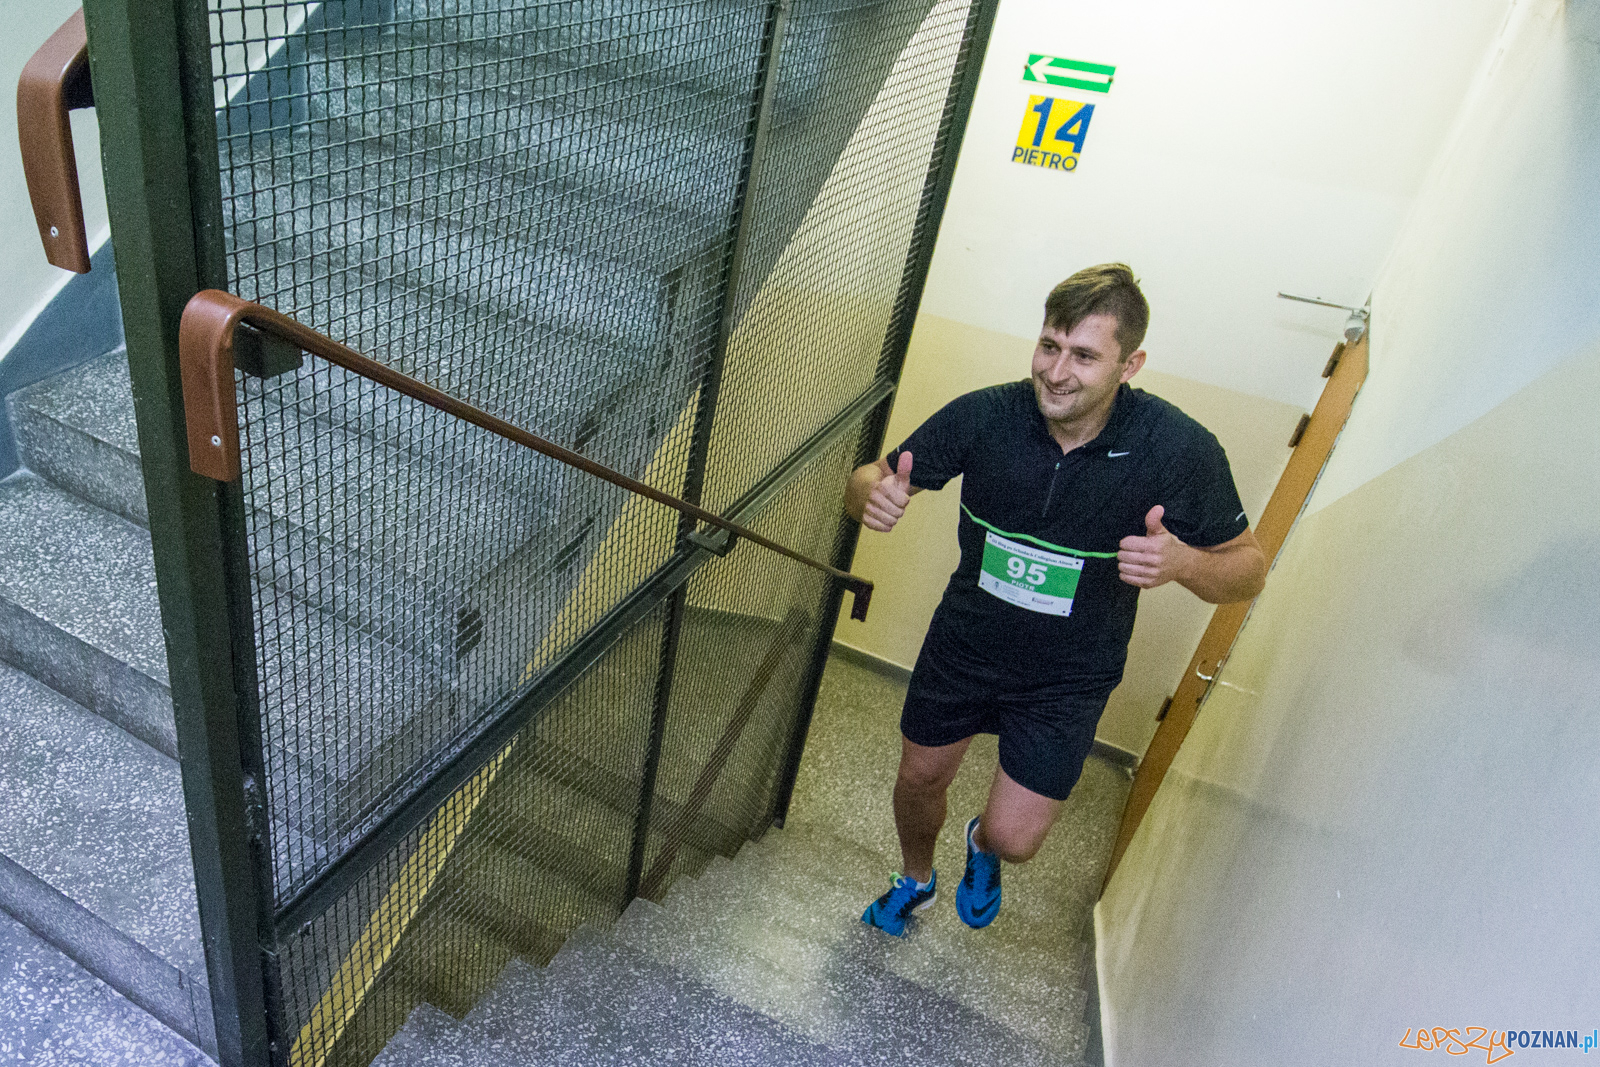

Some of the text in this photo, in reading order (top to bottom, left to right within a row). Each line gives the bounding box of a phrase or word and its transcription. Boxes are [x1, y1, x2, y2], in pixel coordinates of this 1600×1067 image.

[1032, 97, 1095, 154] 14
[1006, 556, 1048, 585] 95
[1011, 579, 1036, 591] PIOTR
